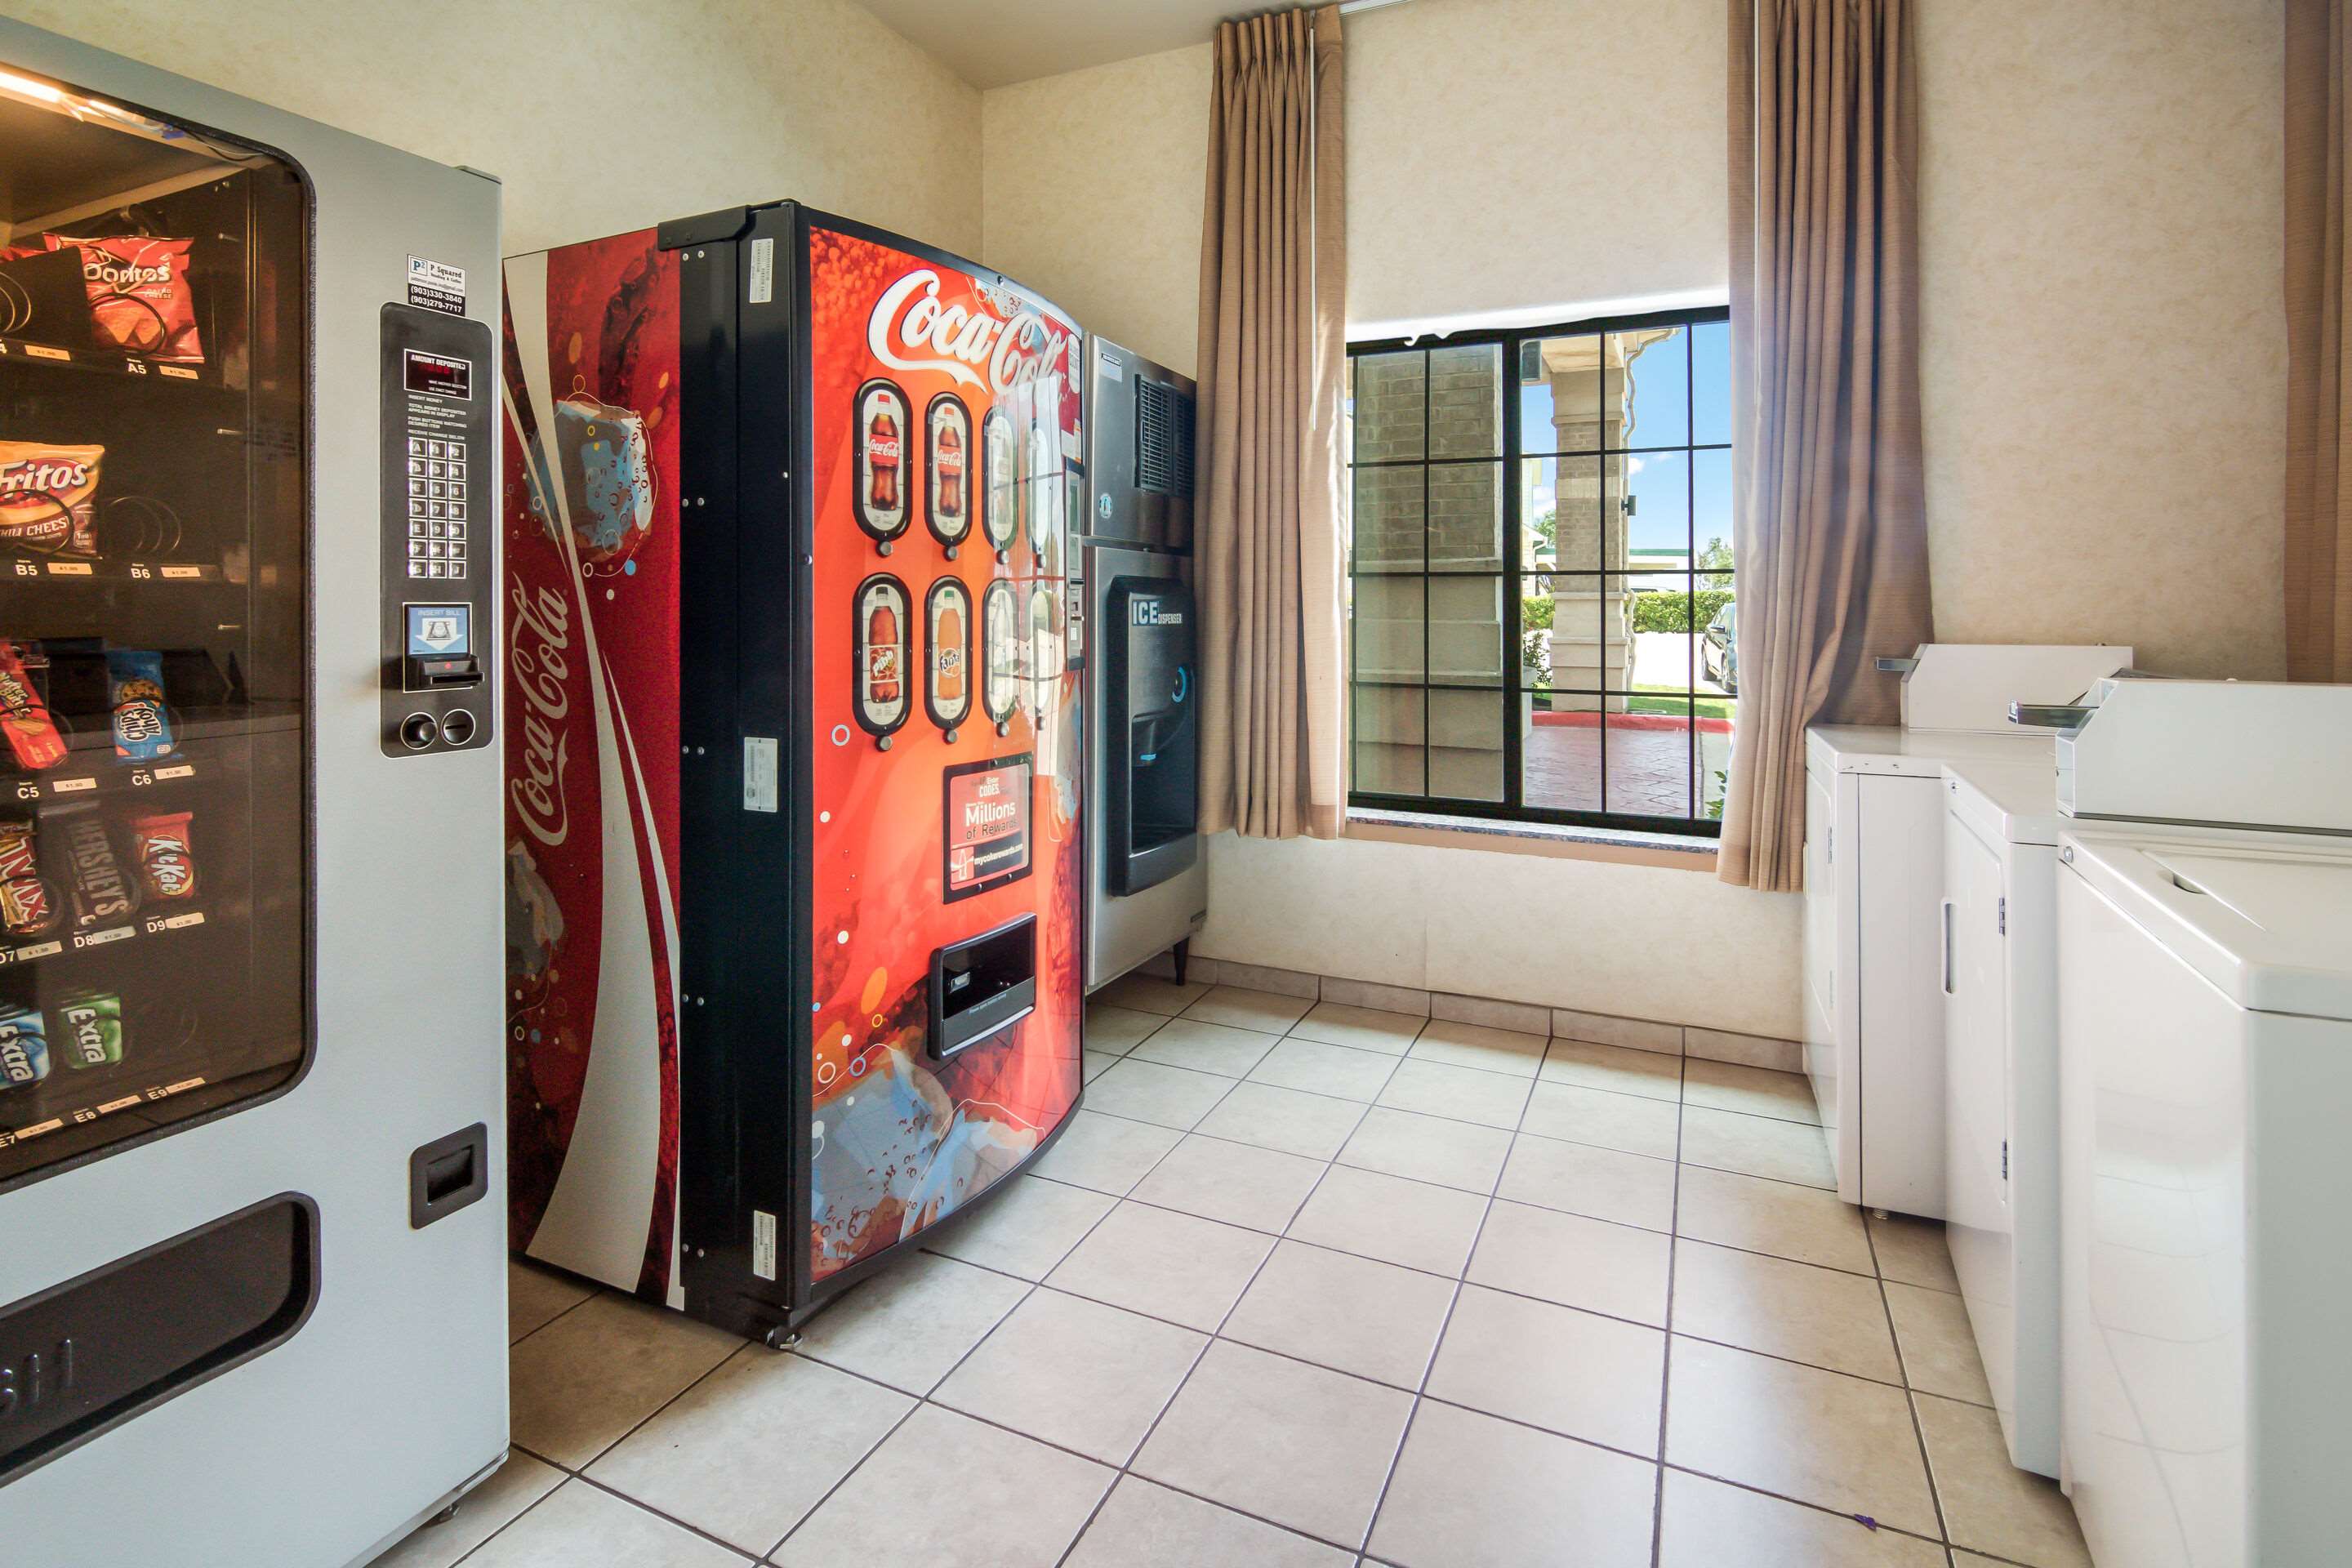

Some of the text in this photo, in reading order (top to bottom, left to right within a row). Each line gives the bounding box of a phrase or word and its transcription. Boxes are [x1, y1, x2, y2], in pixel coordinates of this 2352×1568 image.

[83, 262, 171, 283] Doritos
[437, 266, 462, 279] Squared
[411, 285, 462, 304] (903)330-3840
[411, 295, 462, 314] (903)279-7717
[128, 363, 147, 375] A5
[869, 438, 898, 458] Coca-Cola
[938, 451, 962, 468] Coca-Cola
[0, 460, 88, 500] Fritos
[434, 506, 440, 514] 7
[0, 528, 22, 537] HILI
[434, 526, 441, 535] 9
[16, 564, 38, 576] B5
[131, 568, 151, 579] B6
[1133, 601, 1183, 626] ICE DISPENSER
[940, 652, 960, 673] Fanta
[511, 572, 568, 846] Coca-Cola
[121, 708, 148, 742] Chips
[132, 774, 152, 786] C6
[17, 786, 39, 800] C5
[978, 783, 1000, 799] CODES
[965, 801, 1016, 827] Millions
[966, 818, 1018, 840] of Rewards
[147, 920, 166, 933] D9
[74, 936, 95, 948] D8
[67, 1009, 107, 1063] Extra
[0, 1024, 34, 1083] Extra
[147, 1089, 167, 1100] E9
[74, 1111, 97, 1123] E8
